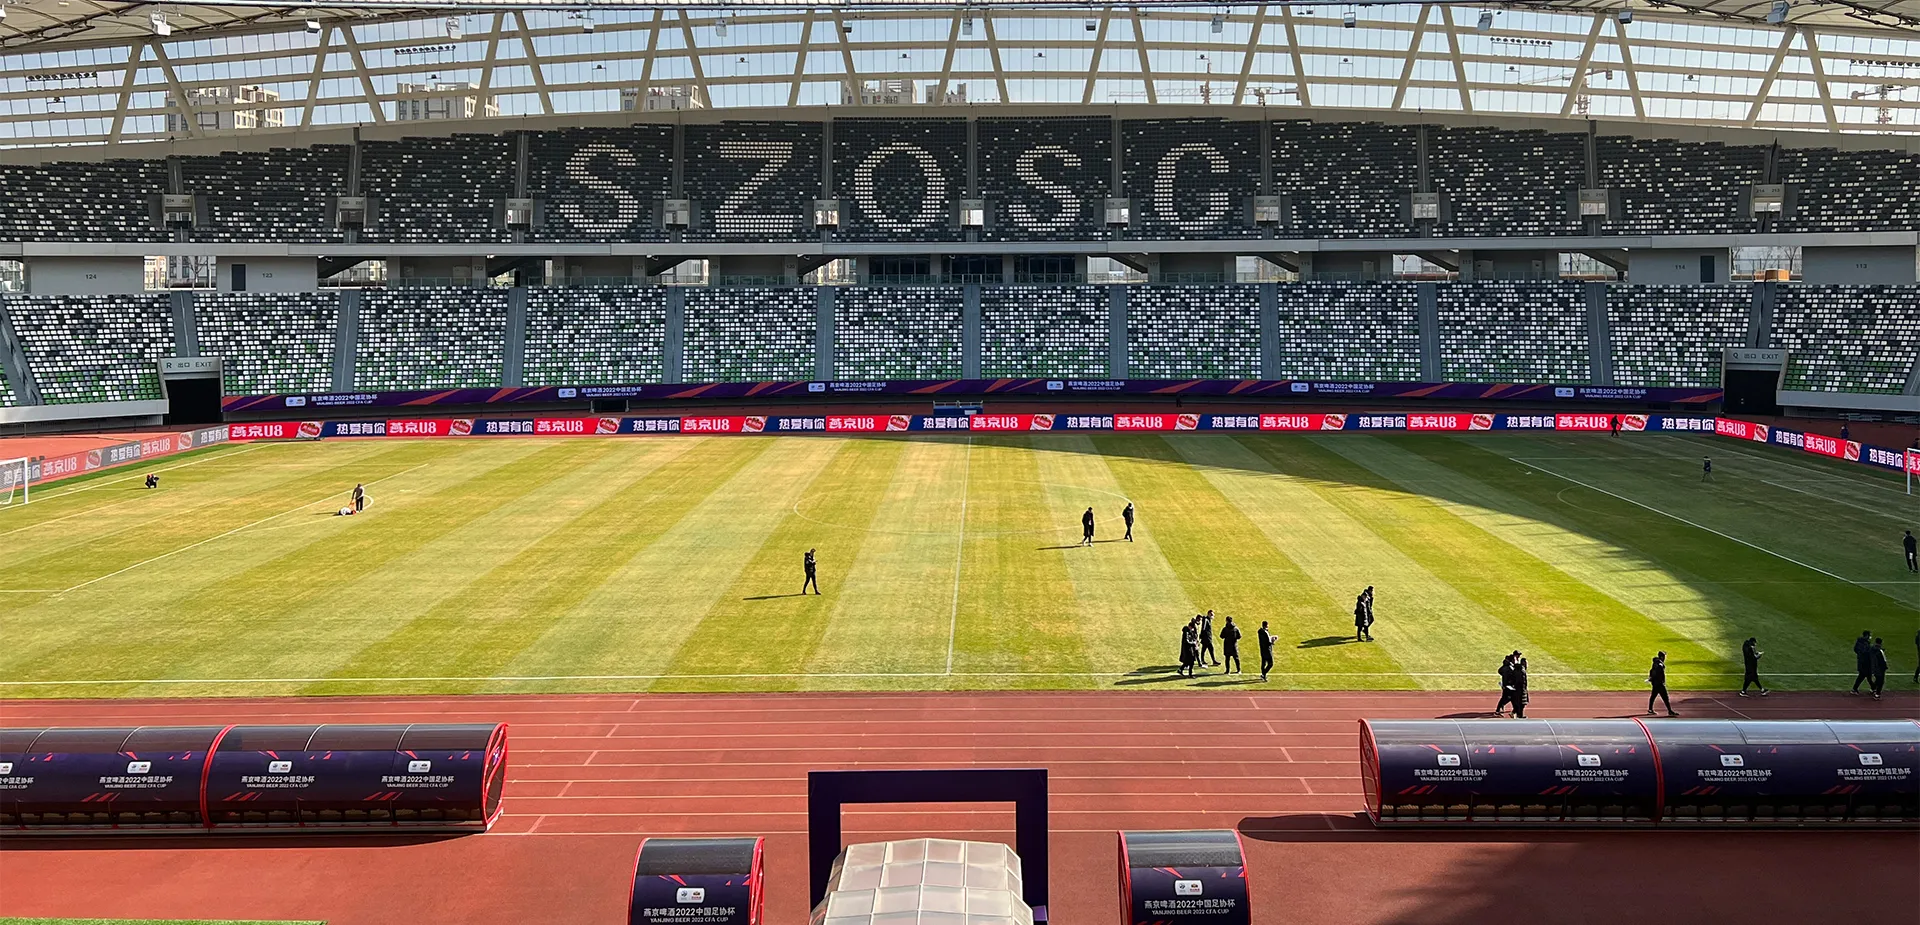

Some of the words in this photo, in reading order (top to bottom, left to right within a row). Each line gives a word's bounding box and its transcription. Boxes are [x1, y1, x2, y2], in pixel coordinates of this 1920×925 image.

[559, 142, 1230, 232] SZOSC
[336, 422, 386, 435] 热爱有你
[390, 421, 437, 434] 燕京U8
[486, 420, 533, 433] 热爱有你
[537, 420, 584, 433] 燕京U8
[633, 419, 680, 432] 热爱有你
[684, 418, 730, 431] 燕京U8
[778, 418, 825, 430] 热爱有你
[829, 417, 875, 430] 燕京U8
[923, 417, 969, 429] 热爱有你
[972, 416, 1019, 429] 燕京U8
[1066, 416, 1113, 428] 热爱有你
[1117, 416, 1163, 429] 燕京U8
[1211, 416, 1259, 428] 热爱有你
[1263, 416, 1309, 429] 燕京U8
[1358, 416, 1406, 428] 热爱有你
[1410, 416, 1457, 428] 燕京U8
[1506, 416, 1555, 428] 热爱有你
[1559, 416, 1608, 429] 燕京U8
[1661, 417, 1715, 431] 热爱有你
[1717, 420, 1746, 437] 燕京U8
[201, 428, 228, 444] 热爱有你
[231, 423, 283, 438] 燕京U8
[1776, 430, 1804, 447] 热爱有你
[1805, 436, 1836, 454] 燕京U8
[142, 438, 171, 455] 燕京U8
[110, 445, 141, 462] 热爱有你
[1869, 449, 1903, 468] 热爱有你
[43, 457, 77, 477] 燕京U8
[1414, 769, 1488, 777] 燕京啤酒2022中国足协杯
[1555, 769, 1629, 777] 燕京啤酒2022中国足协杯
[1697, 769, 1772, 777] 燕京啤酒2022中国足协杯
[1837, 768, 1911, 776] 燕京啤酒2022中国足协杯
[99, 776, 173, 784] 燕京啤酒2022中国足协杯
[381, 775, 454, 783] 燕京啤酒2022中国足协杯
[1144, 899, 1236, 909] 燕京啤酒2022中国足协杯
[643, 907, 736, 917] 燕京啤酒2022中国足协杯
